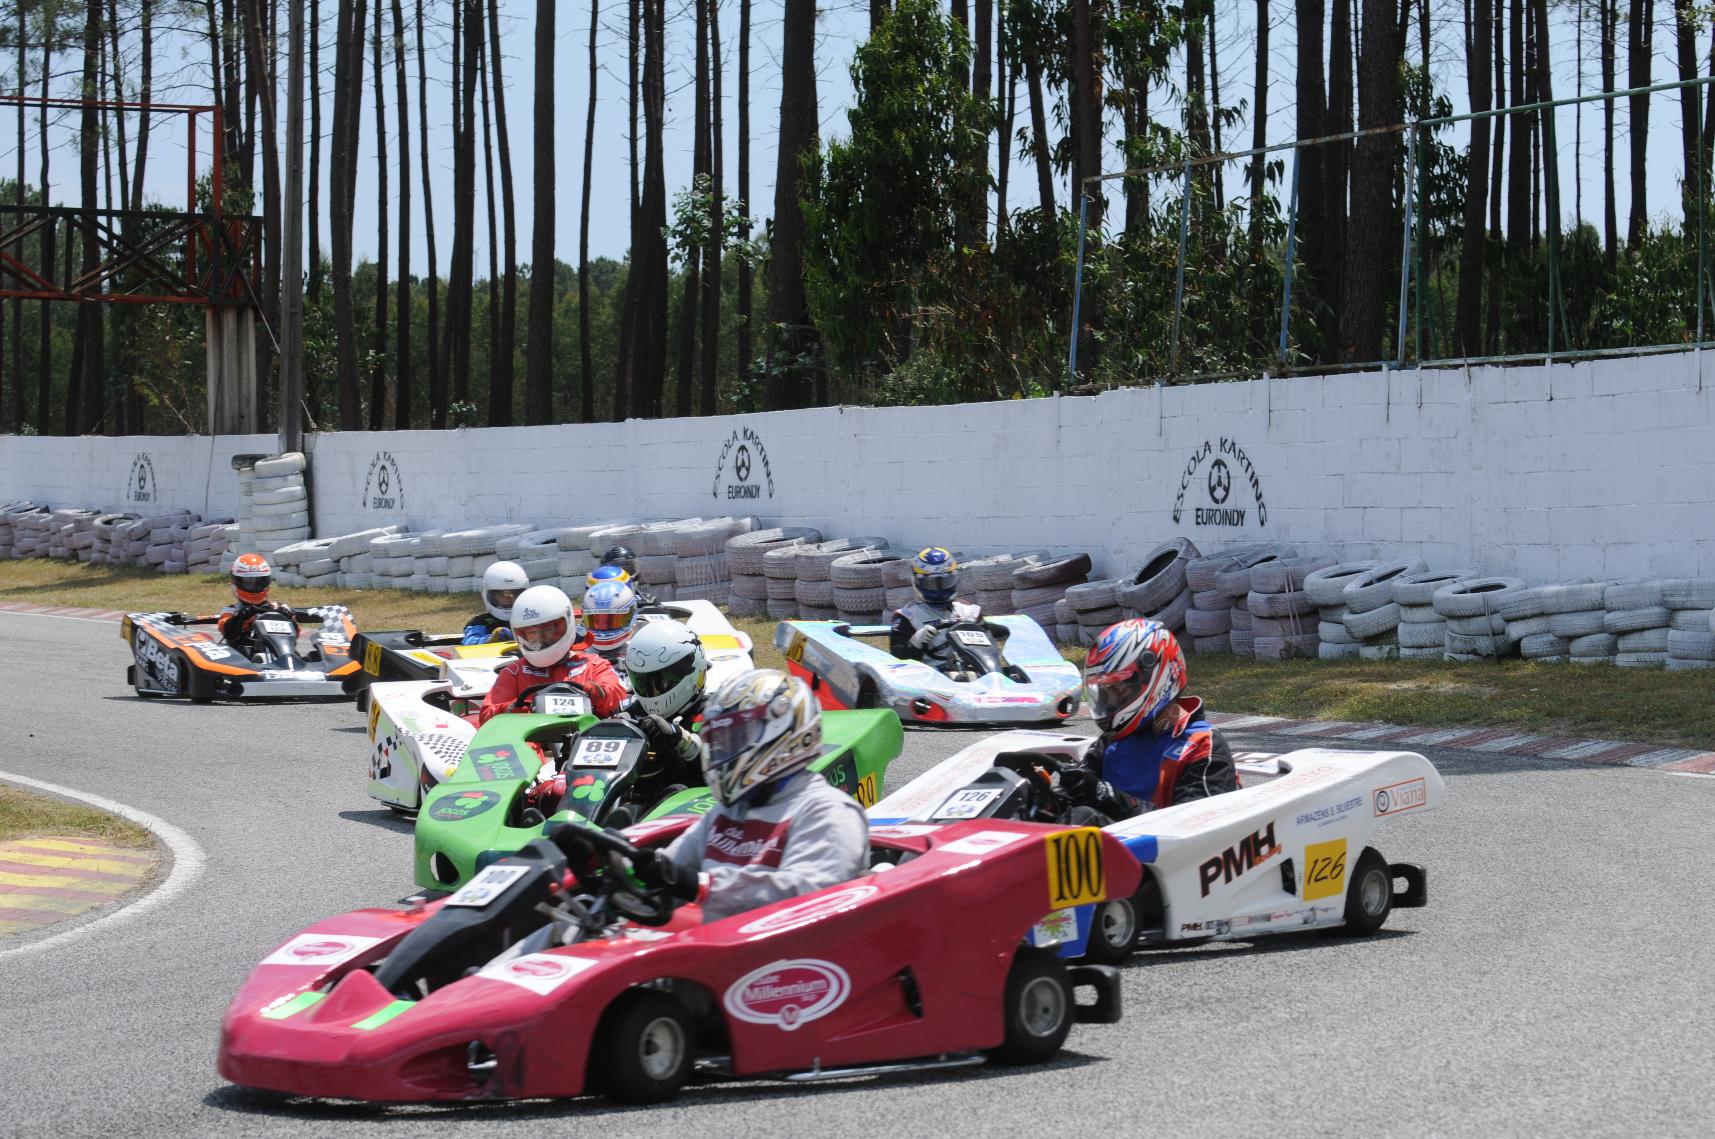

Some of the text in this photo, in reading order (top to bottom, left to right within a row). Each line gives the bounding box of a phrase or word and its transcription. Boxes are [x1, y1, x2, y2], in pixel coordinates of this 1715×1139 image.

[727, 484, 761, 500] EUROINDY
[1172, 436, 1268, 528] ESCOLA KARTING
[1194, 507, 1247, 527] EUROINDY
[551, 698, 576, 707] 124
[585, 741, 621, 753] 89
[959, 791, 992, 802] 126
[1390, 784, 1425, 808] Viana
[1052, 831, 1103, 902] 100
[1199, 820, 1276, 899] PMH
[1306, 851, 1347, 886] 126
